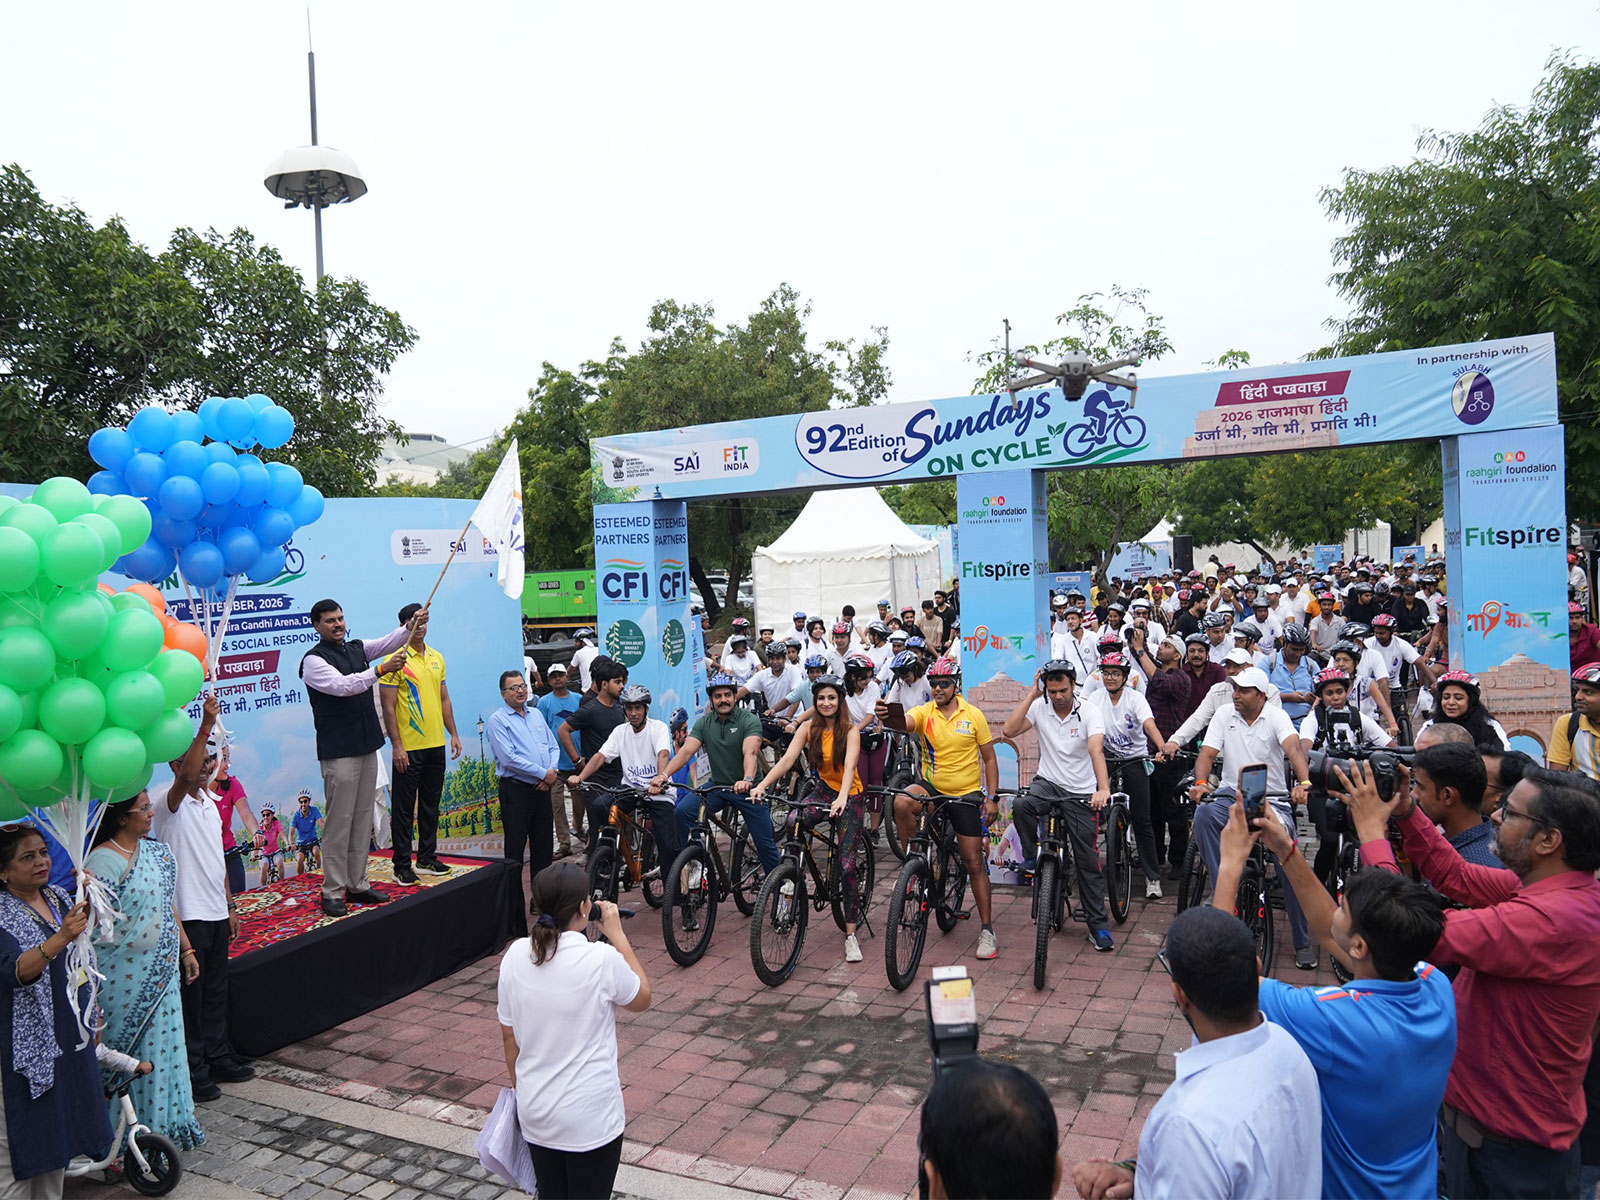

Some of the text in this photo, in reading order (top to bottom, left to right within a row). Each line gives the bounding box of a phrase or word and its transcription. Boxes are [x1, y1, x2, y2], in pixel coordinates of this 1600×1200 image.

[1417, 345, 1529, 366] In partnership with
[1452, 363, 1492, 378] SULABH
[1239, 380, 1327, 401] हिंदी पखवाड़ा
[1220, 397, 1349, 423] 2026 राजभाषा हिंदी
[805, 391, 1051, 464] 92nd Edition of Sundays
[1226, 424, 1247, 441] भी,
[1252, 421, 1278, 437] गति
[1283, 419, 1306, 436] भी,
[1310, 414, 1349, 433] प्रगति
[1353, 412, 1377, 428] भी!
[674, 455, 700, 472] SAI
[927, 436, 1052, 476] ON CYCLE
[724, 462, 749, 472] INDIA
[1465, 463, 1557, 478] raahgiri foundation
[962, 507, 989, 519] raahgiri
[991, 507, 1028, 516] foundation
[595, 516, 651, 529] ESTEEMED
[654, 517, 687, 530] ESTEEMED
[595, 533, 650, 545] PARTNERS
[655, 534, 687, 546] PARTNERS
[602, 571, 649, 599] CFI
[659, 571, 687, 600] CFI
[259, 598, 284, 609] 2026
[241, 617, 273, 631] Gandhi
[274, 614, 301, 628] Arena,
[221, 642, 229, 651] &
[231, 637, 271, 651] SOCIAL
[223, 659, 265, 674] पखवाड़ा
[213, 682, 257, 698] राजभाषा
[259, 674, 281, 692] हिंदी
[1507, 677, 1533, 685] INDIA
[234, 696, 252, 712] भी,
[254, 691, 282, 710] प्रगति
[285, 689, 302, 703] भी!
